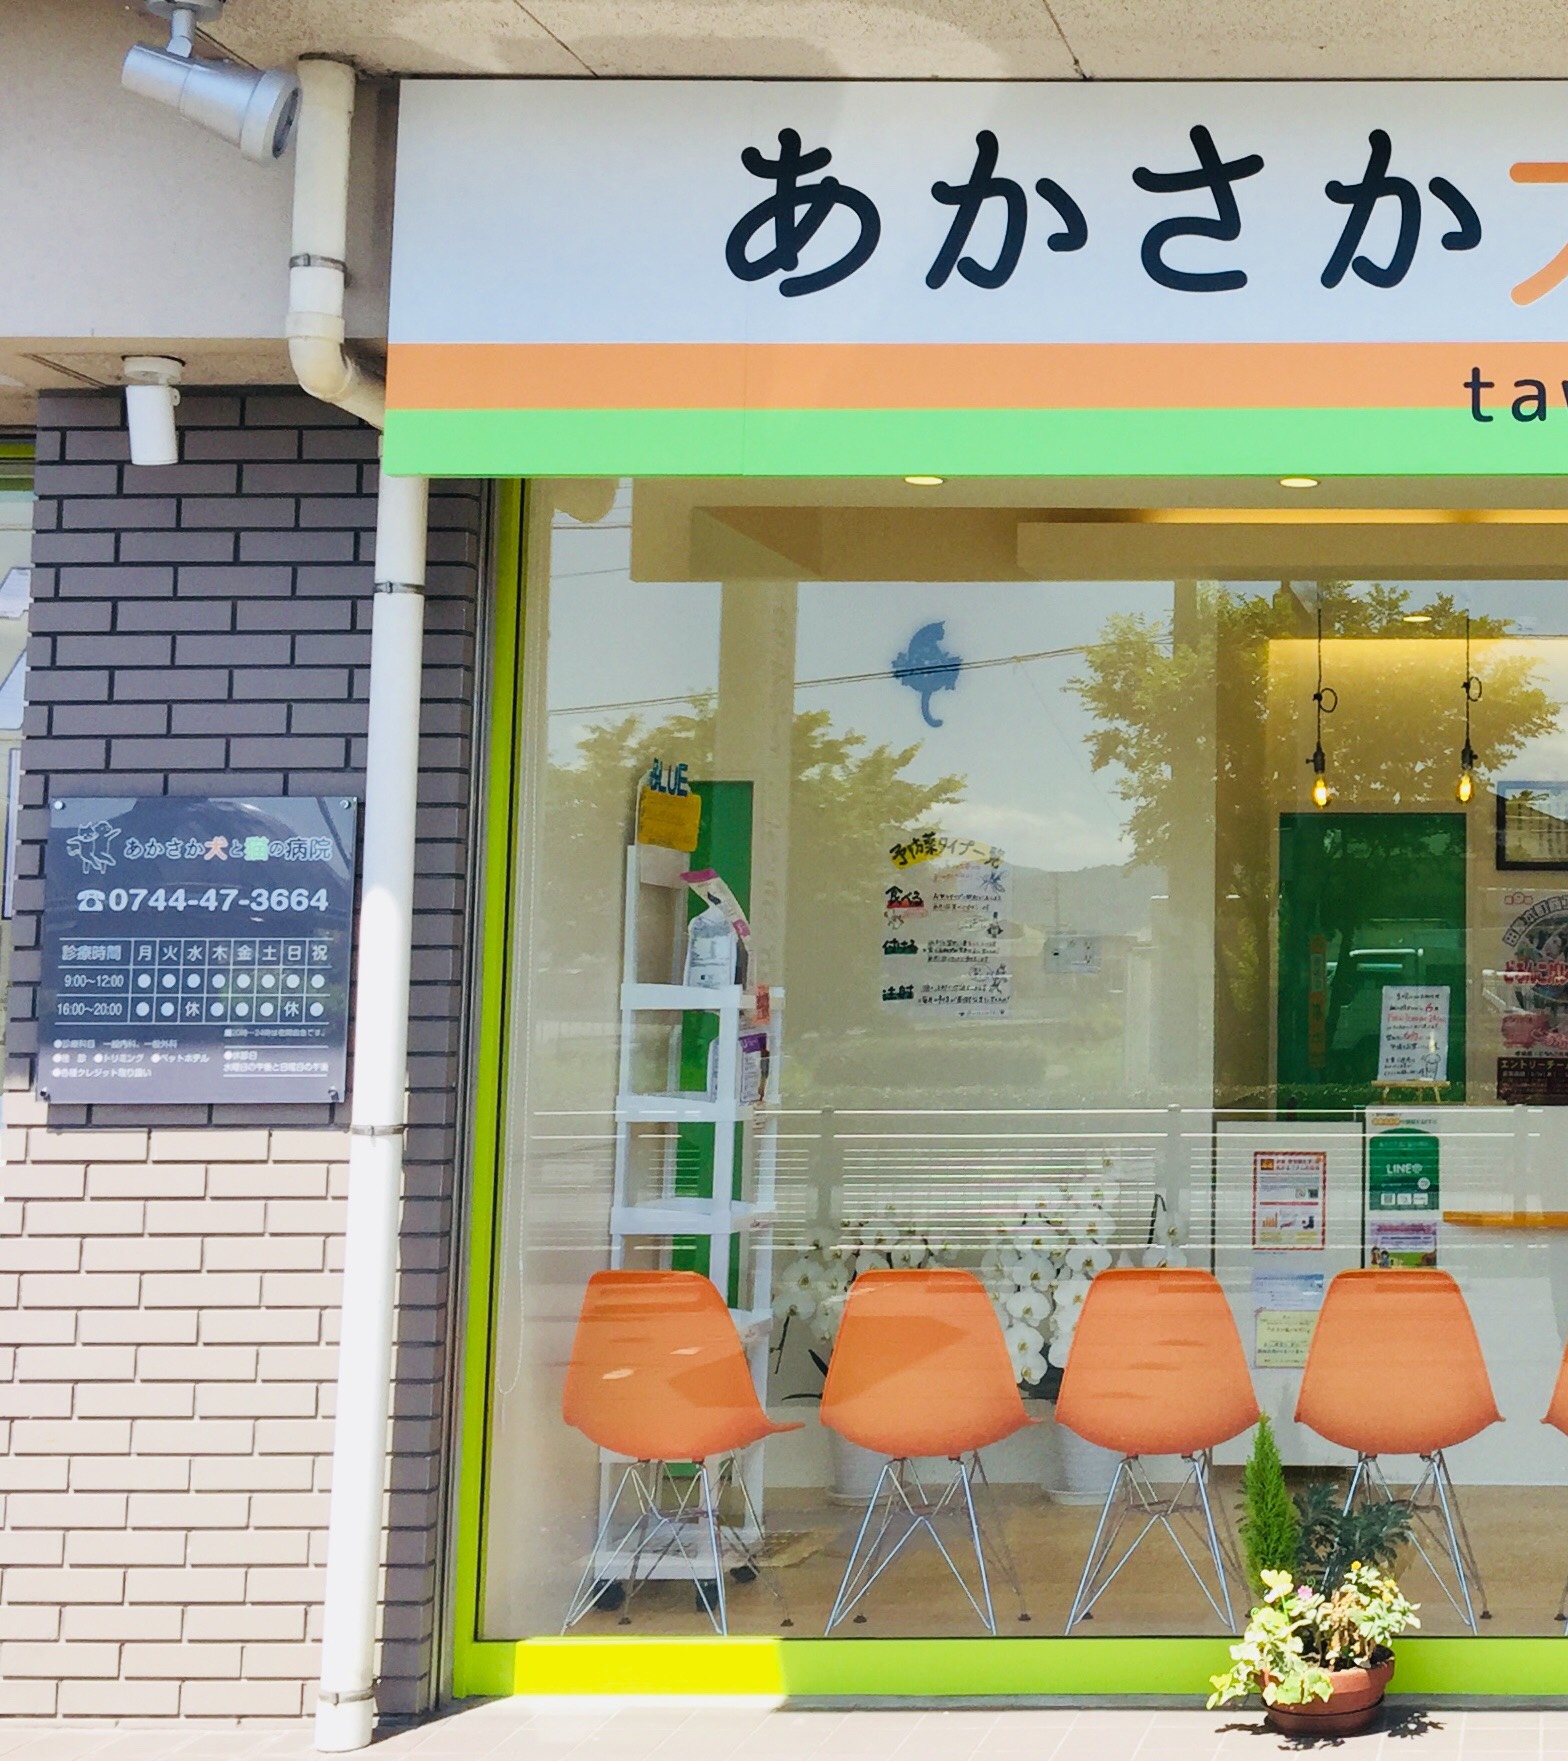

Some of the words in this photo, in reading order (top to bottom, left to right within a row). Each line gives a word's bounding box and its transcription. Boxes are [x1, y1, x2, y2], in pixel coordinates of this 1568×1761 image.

[123, 836, 332, 862] あかさか犬と猫の病院
[108, 888, 329, 912] 0744-47-3664
[137, 945, 152, 962] 月
[162, 946, 178, 962] 火
[187, 946, 203, 962] 水
[212, 946, 228, 962] 木
[236, 945, 253, 962] 金
[261, 946, 278, 962] 土
[287, 946, 301, 962] 日
[312, 945, 328, 962] 祝
[184, 1002, 201, 1016] 休
[283, 1002, 299, 1016] 休
